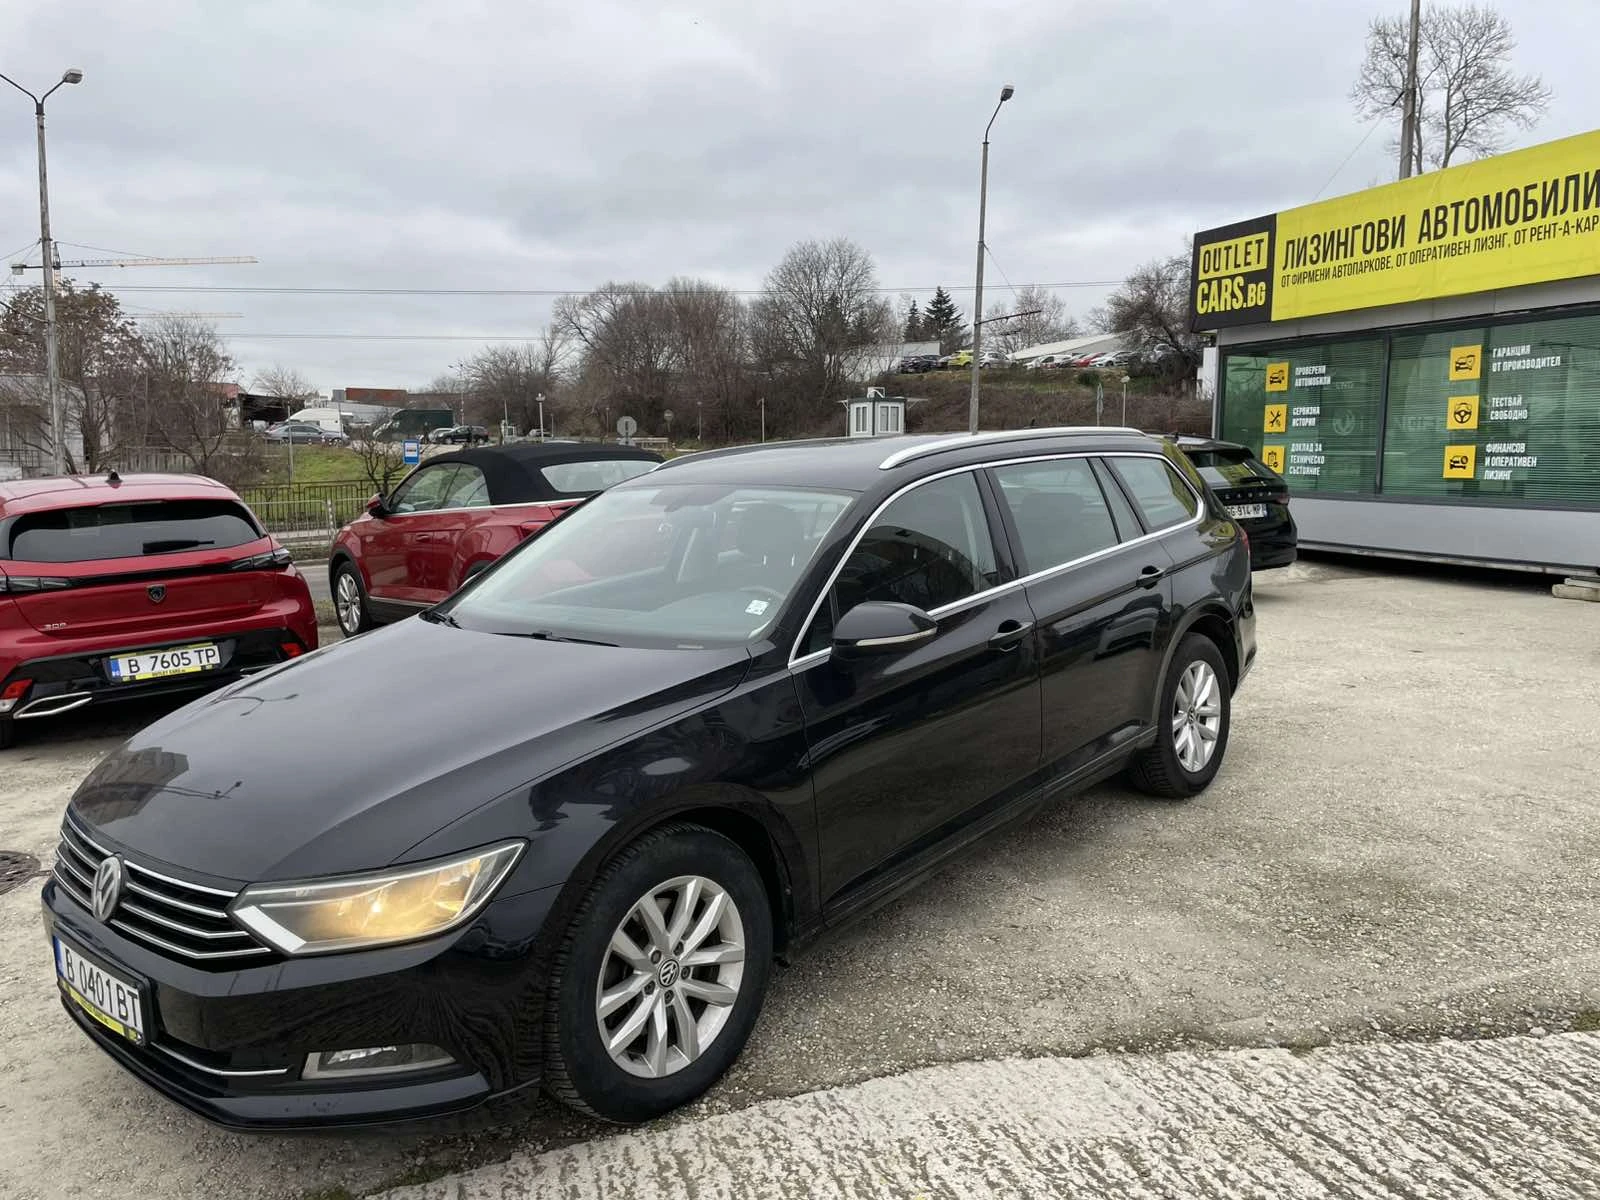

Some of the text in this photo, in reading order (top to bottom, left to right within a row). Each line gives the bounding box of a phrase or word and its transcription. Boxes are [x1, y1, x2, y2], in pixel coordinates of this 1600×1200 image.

[1282, 169, 1600, 270] ЛИЗИНГОВИ АВТОМОБИЛИ
[1202, 238, 1265, 274] OUTLET
[1281, 274, 1291, 288] ОТ
[1291, 267, 1331, 287] ФИРМЕНИ
[1331, 255, 1394, 279] АВТОПАРКОВЕ,
[1395, 253, 1408, 267] ОТ
[1409, 239, 1475, 265] ОПЕРАТИВЕН
[1513, 228, 1528, 246] ОТ
[1530, 215, 1599, 243] РЕНТ-А-КАР
[1196, 276, 1267, 314] CARS.BG
[1492, 344, 1531, 358] ГАРАНЦИЯ
[1492, 356, 1561, 372] ОТ ПРОИЗВОДИТЕЛ
[1492, 394, 1523, 407] ТЕСТВАЙ
[1490, 409, 1528, 420] СВОБОДНО
[1485, 443, 1526, 453] ФИНАНСОВ
[1484, 456, 1538, 467] И ОПЕРАТИВЕН
[1484, 470, 1513, 480] ЛИЗИНГ
[128, 648, 216, 674] B 7605 TP
[65, 949, 75, 983] B
[79, 960, 113, 1014] 0401
[116, 983, 139, 1027] BT
